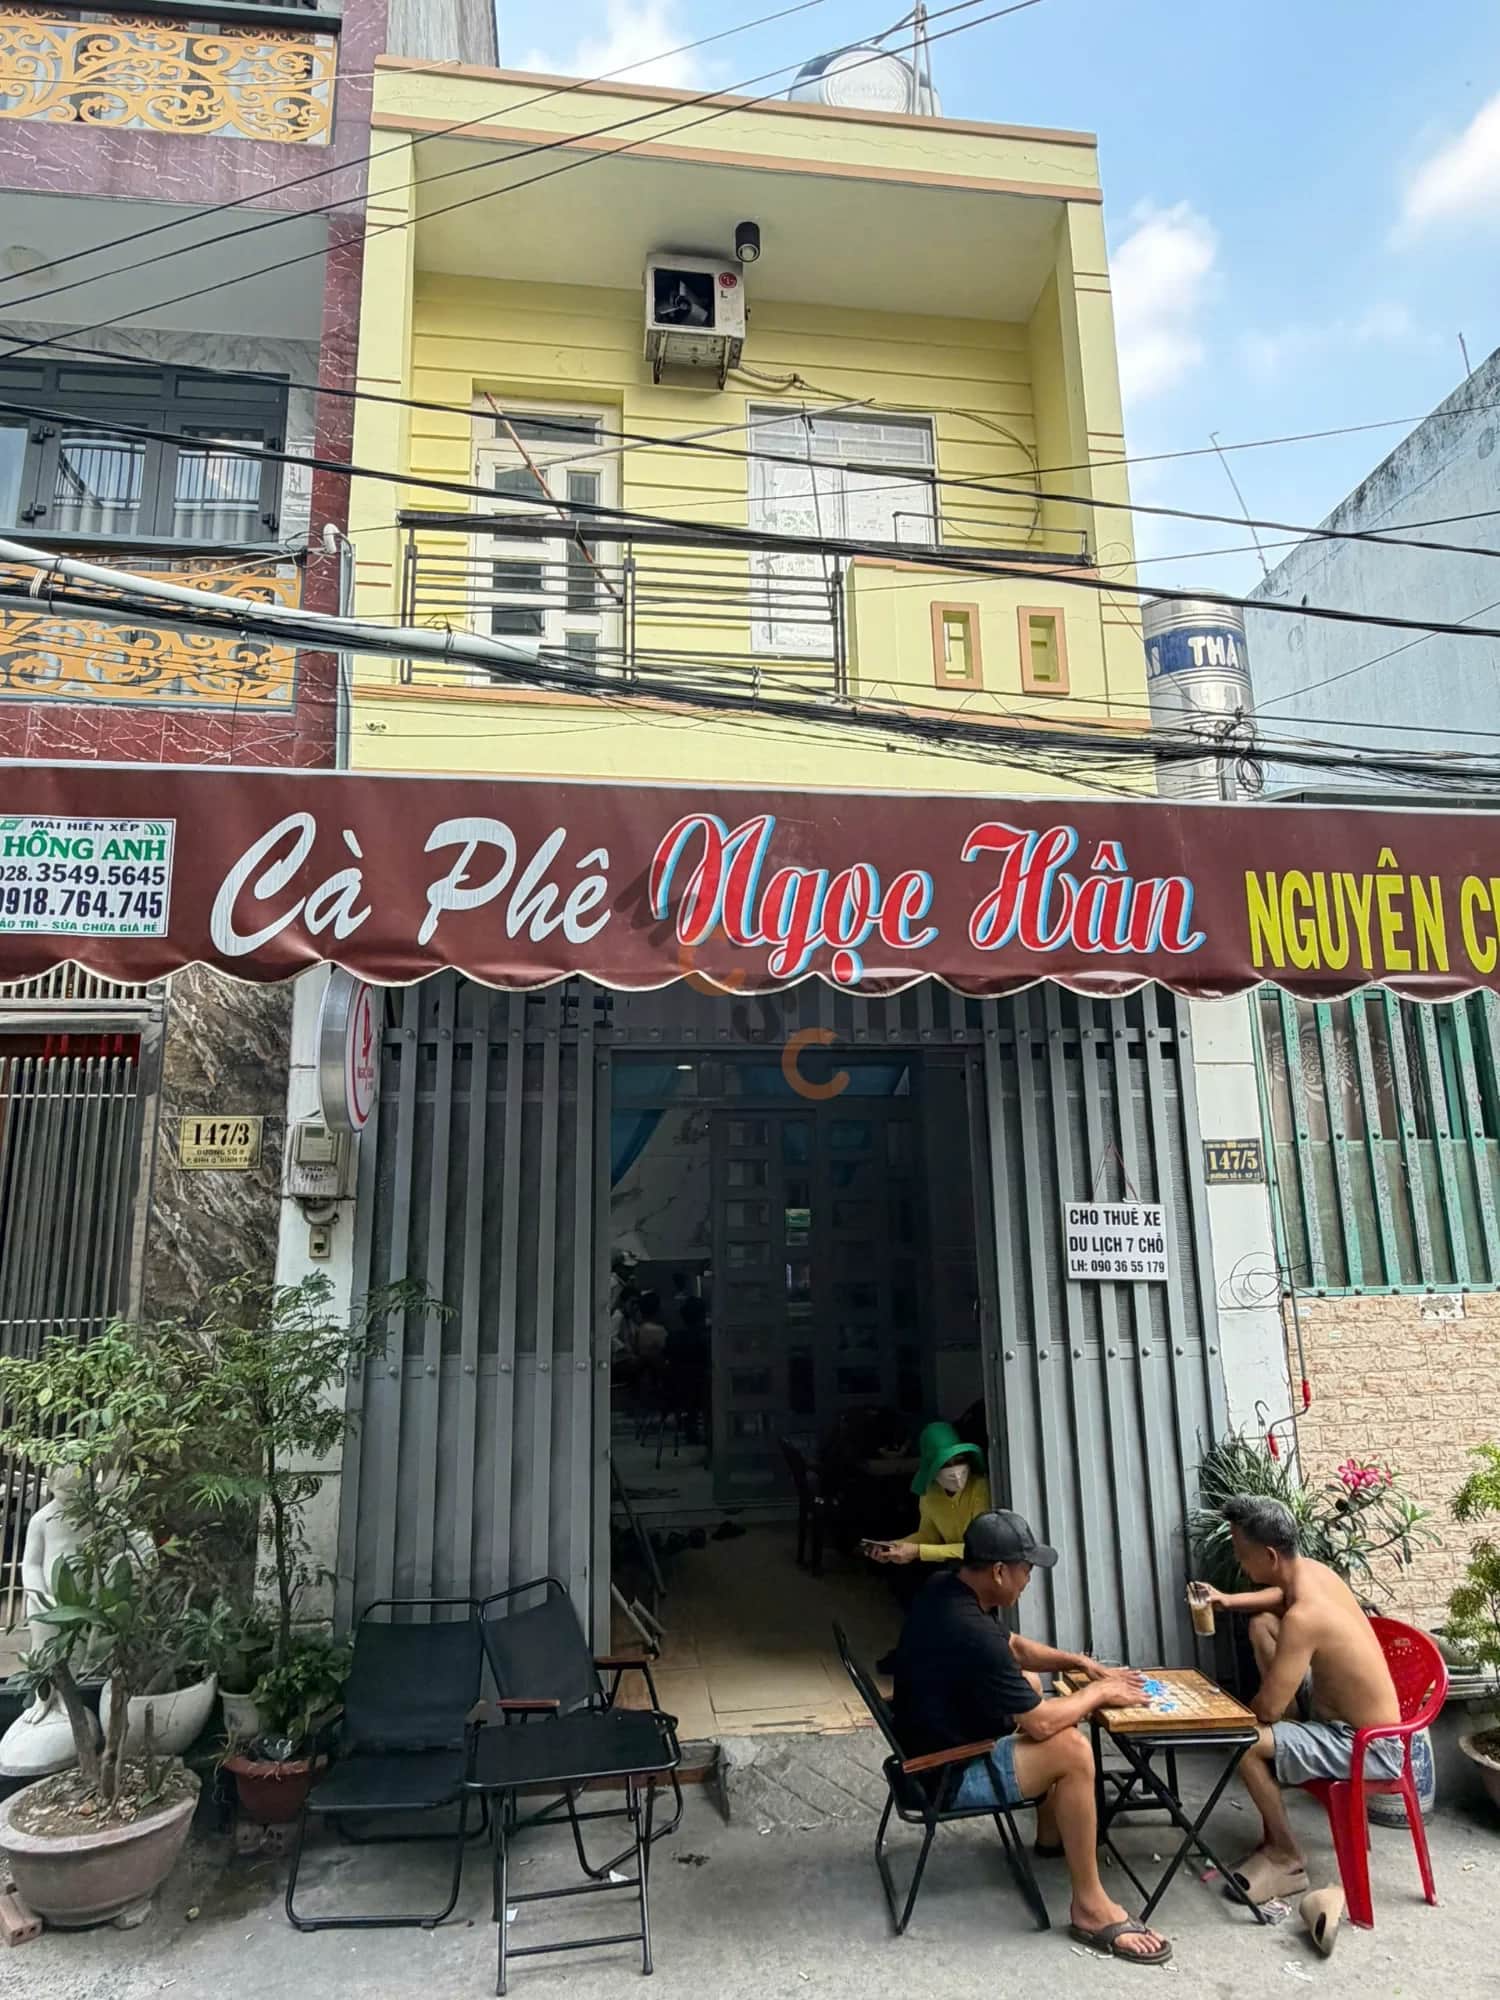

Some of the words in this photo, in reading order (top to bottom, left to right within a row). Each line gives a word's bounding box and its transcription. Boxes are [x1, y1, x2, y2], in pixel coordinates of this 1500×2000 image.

[101, 838, 165, 861] ANH
[210, 812, 371, 956] Cà
[418, 817, 611, 945] Phê
[649, 813, 938, 985] Ngọc
[961, 822, 1207, 953] Hân
[1245, 847, 1449, 972] NGUYÊN
[194, 1123, 249, 1146] 147/3
[1209, 1150, 1258, 1170] 147/5
[1070, 1209, 1099, 1225] CHO
[1103, 1207, 1139, 1226] THUÊ
[1143, 1211, 1161, 1226] XE
[1069, 1236, 1087, 1252] DU
[1092, 1237, 1122, 1256] LỊCH
[1126, 1237, 1134, 1252] 7
[1071, 1260, 1088, 1272] LH:
[1091, 1260, 1111, 1272] 090
[1114, 1260, 1128, 1272] 36
[1130, 1261, 1144, 1272] 55
[1147, 1261, 1165, 1273] 179
